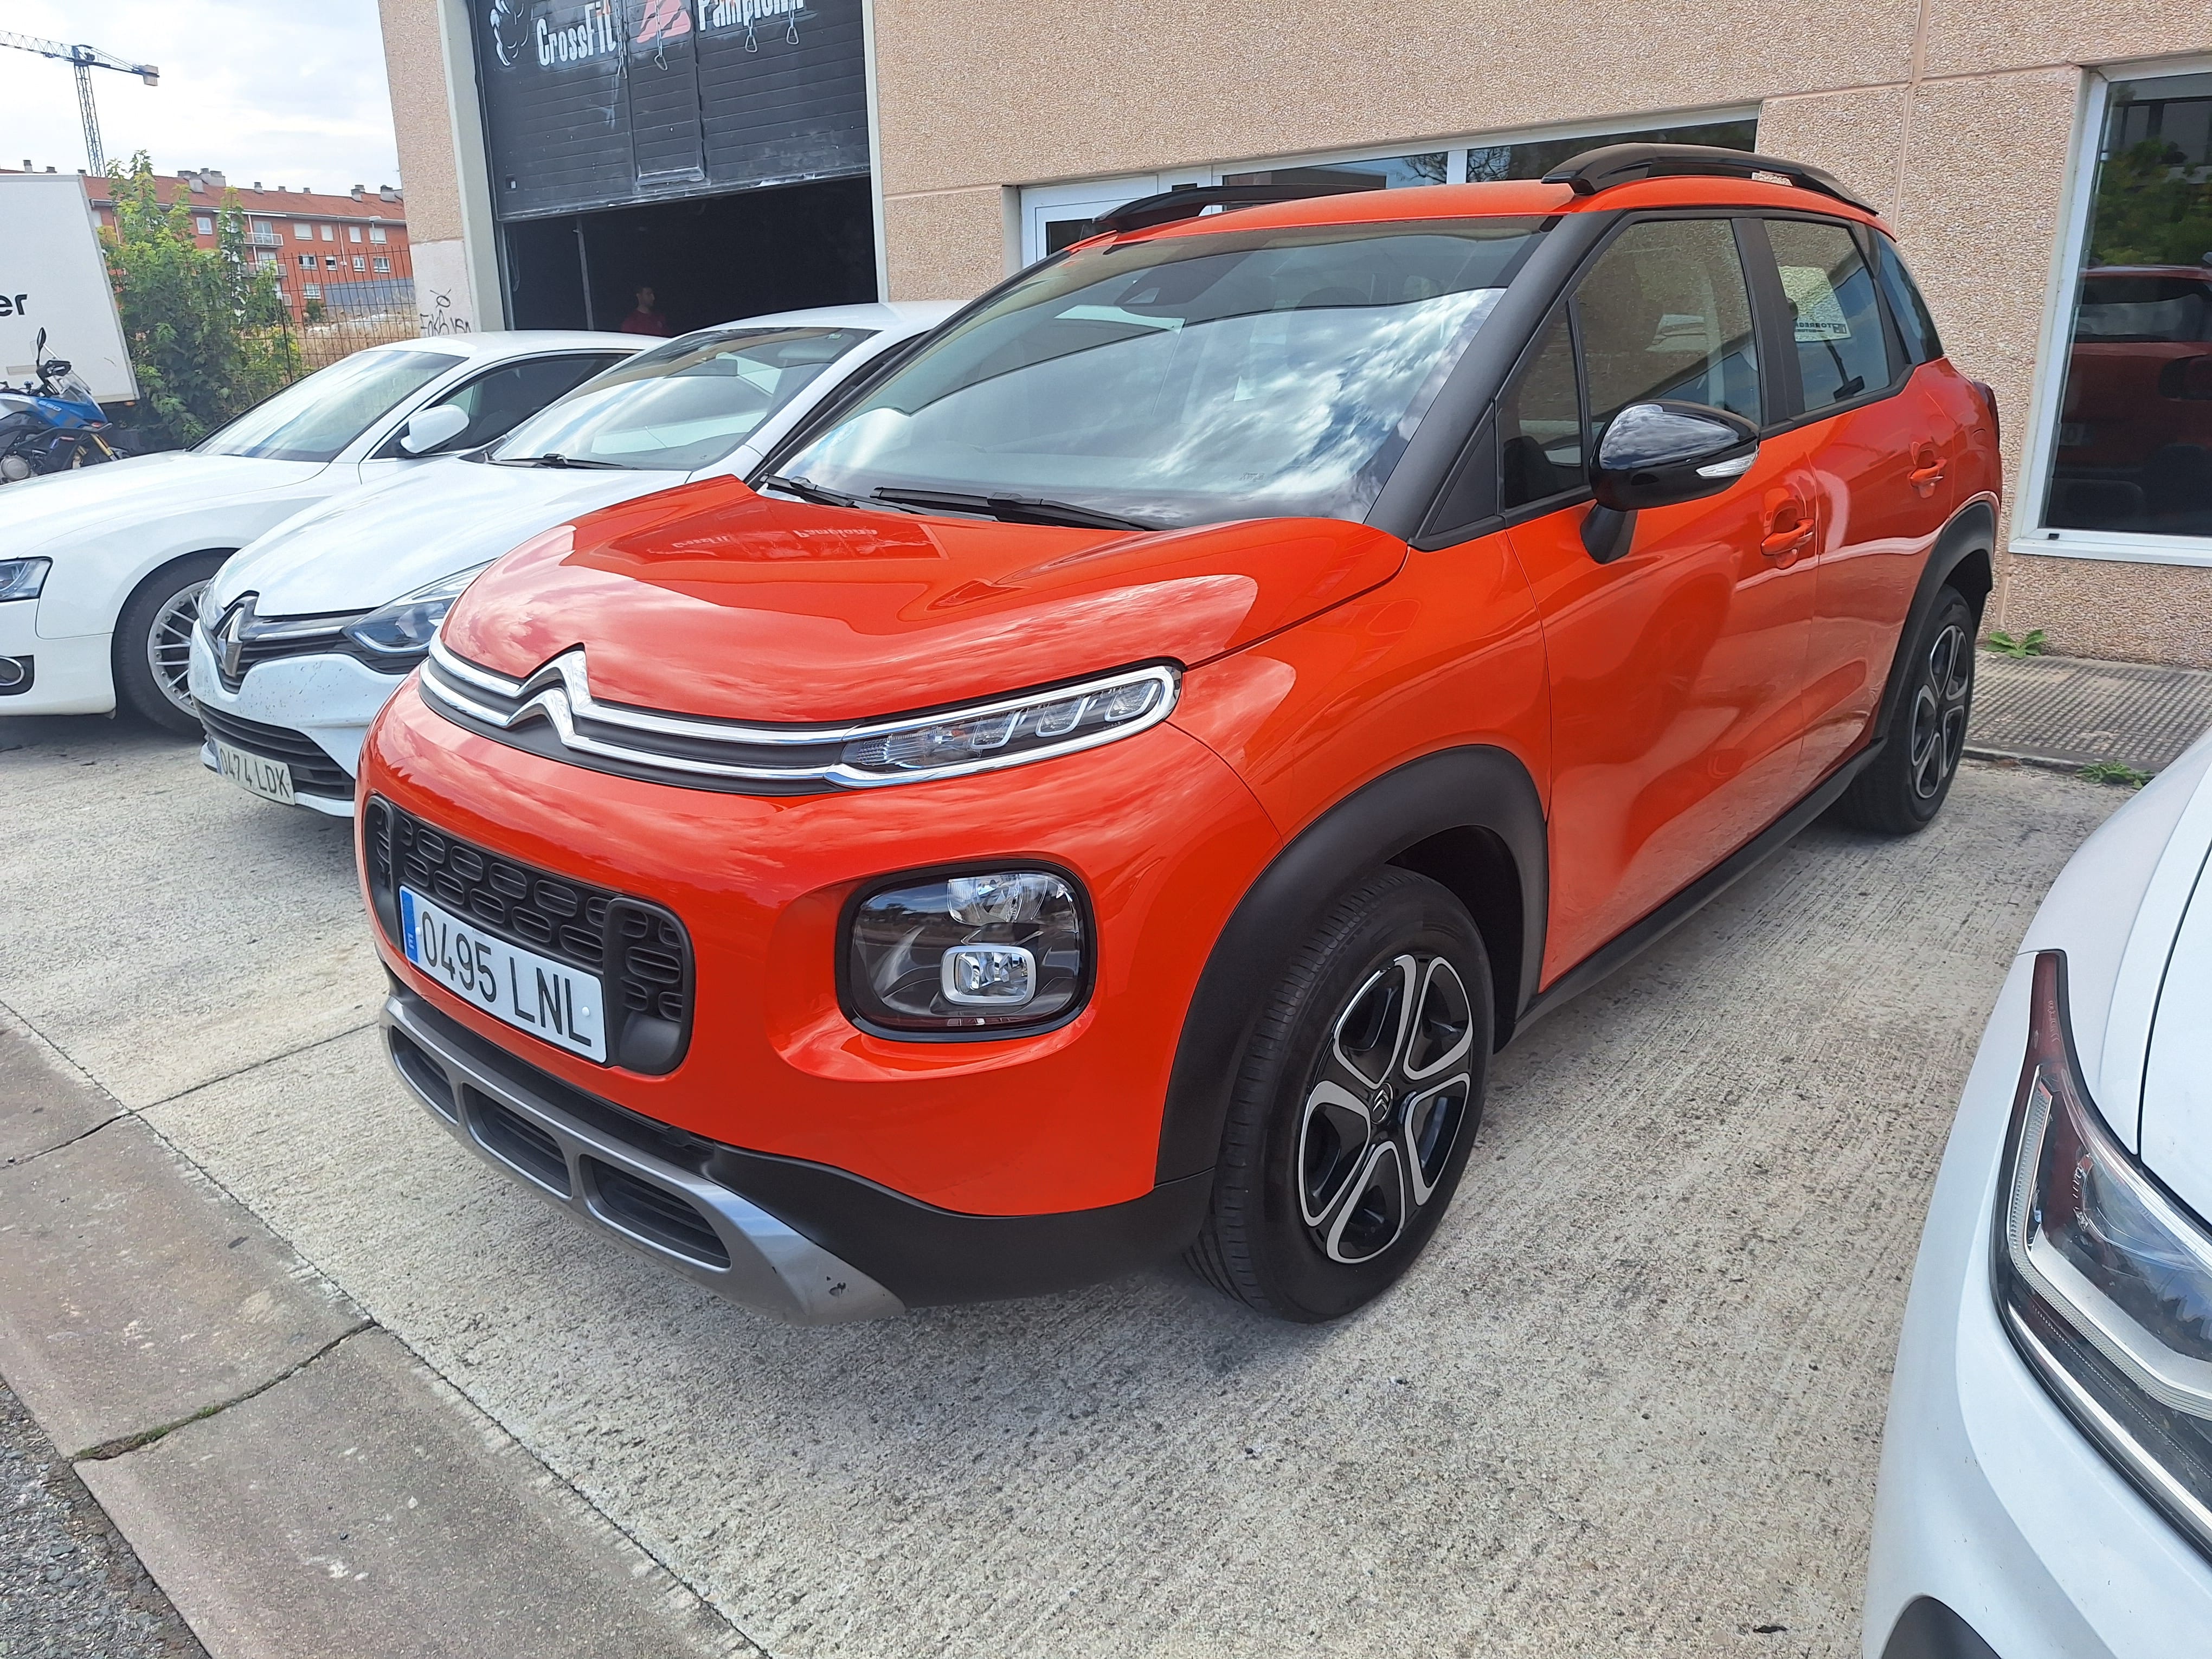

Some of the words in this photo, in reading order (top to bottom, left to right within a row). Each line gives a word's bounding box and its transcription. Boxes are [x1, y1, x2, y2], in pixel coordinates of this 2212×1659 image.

[536, 0, 616, 66] CrossFit
[220, 748, 253, 787] 0474
[255, 759, 290, 798] LDK
[408, 933, 415, 949] E
[422, 911, 497, 1003] 0495
[510, 956, 592, 1047] LNL
